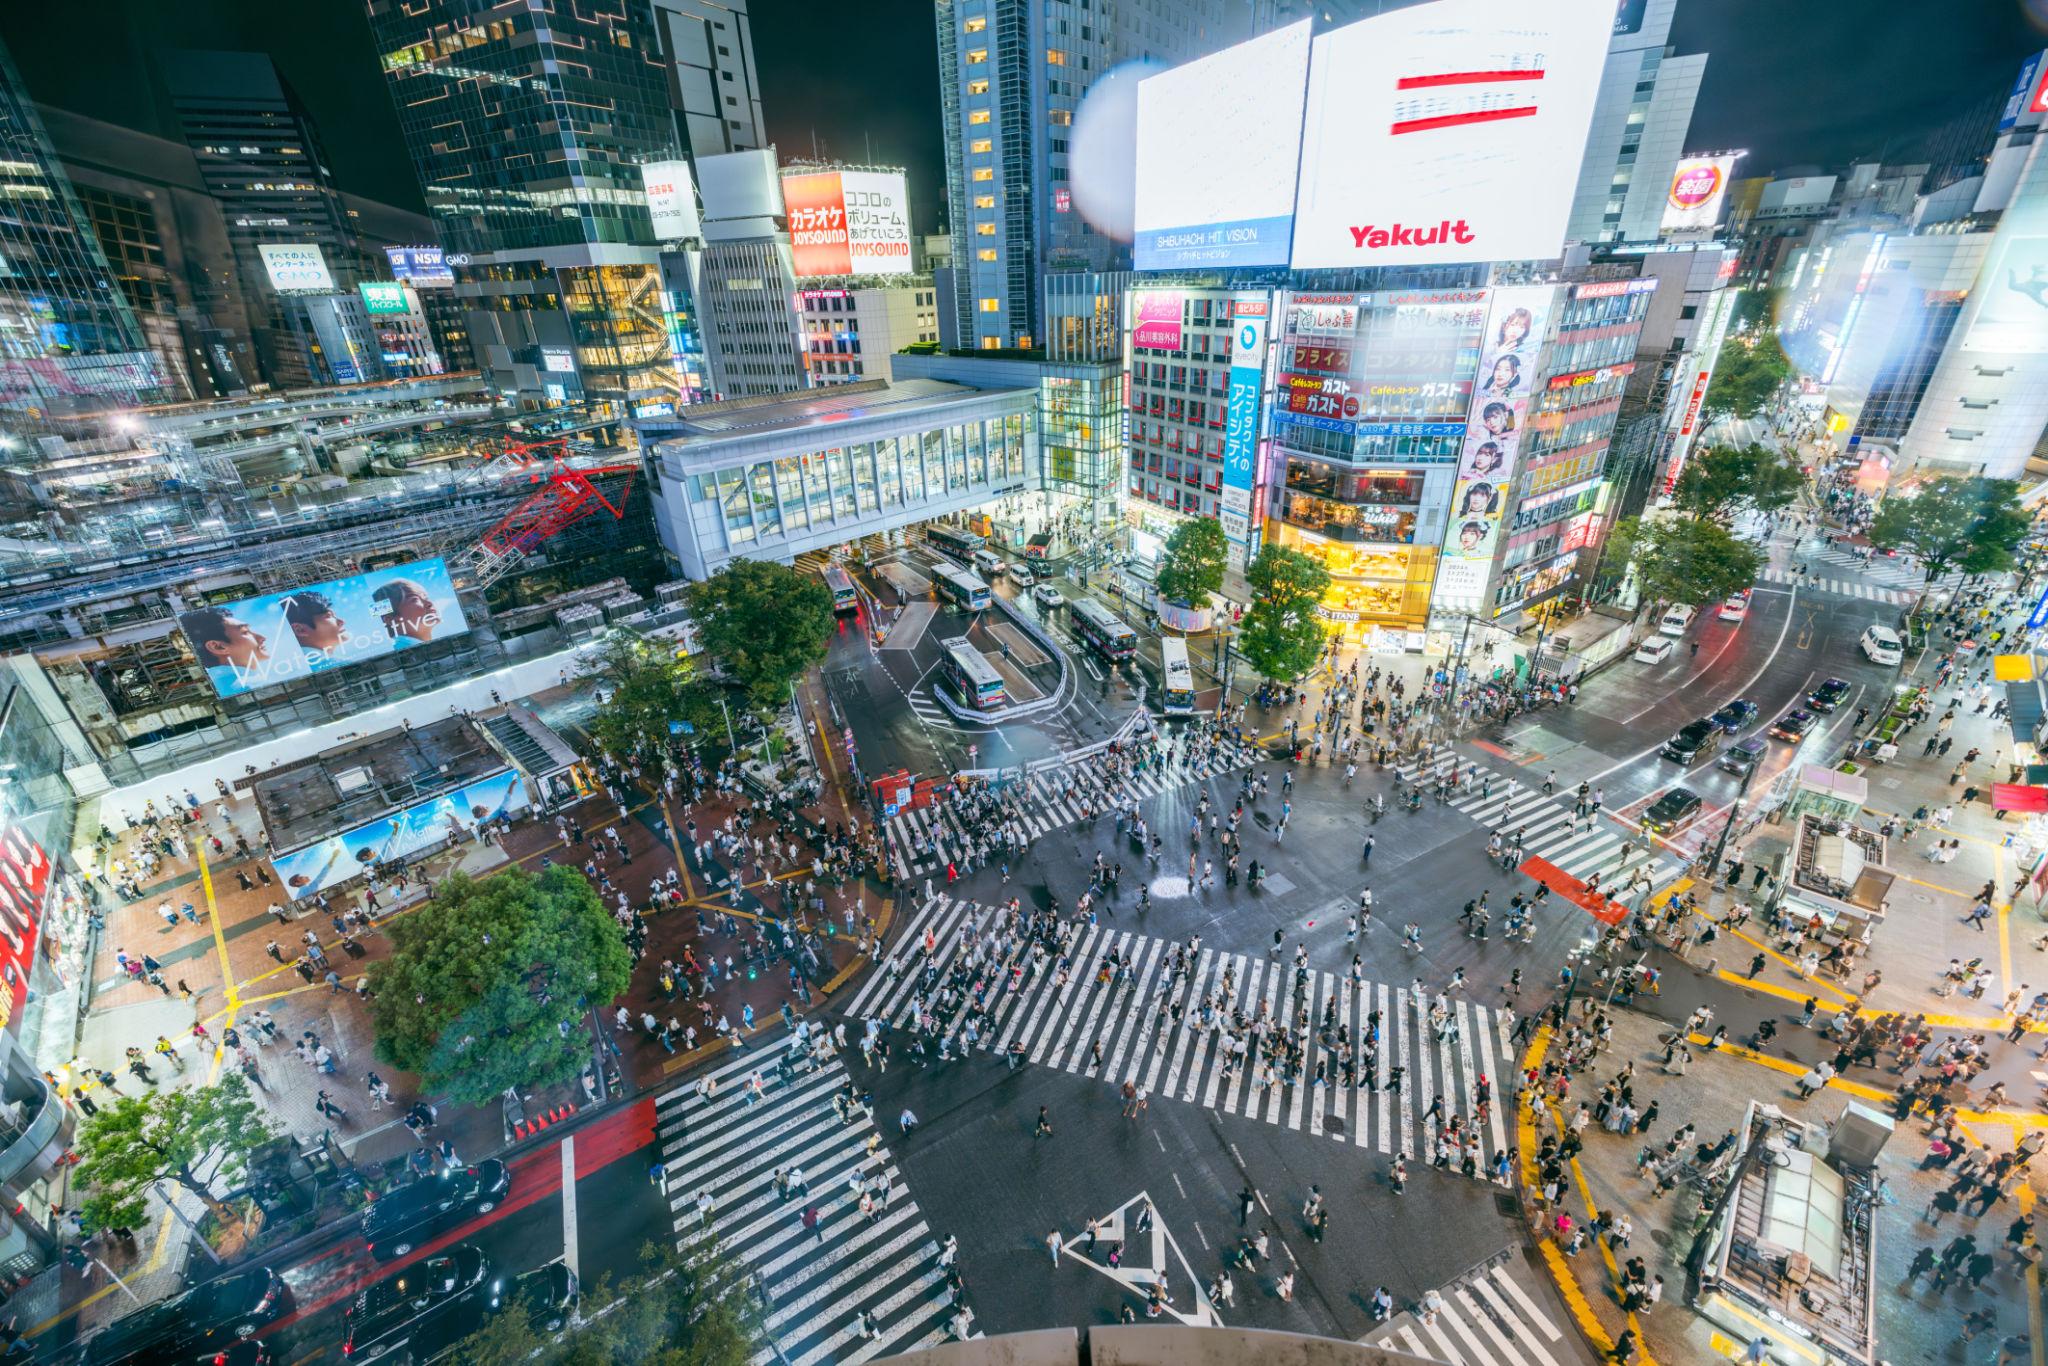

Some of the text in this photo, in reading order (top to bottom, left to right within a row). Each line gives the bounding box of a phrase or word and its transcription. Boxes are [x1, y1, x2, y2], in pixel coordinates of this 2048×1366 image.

[1676, 178, 1715, 195] 楽園
[846, 192, 891, 207] ココロの
[790, 206, 843, 229] カラオケ
[848, 209, 906, 226] ボリューム、
[794, 229, 847, 246] JOYSOUND
[1157, 228, 1258, 248] SHIBUHACHI HIT VISION
[1349, 220, 1476, 248] Yakult
[268, 252, 316, 260] すべての人に
[851, 242, 908, 257] JOYSOUND
[272, 260, 319, 268] インターネット
[391, 254, 406, 265] NSW
[414, 253, 442, 264] NSW
[446, 254, 469, 266] GMO
[276, 271, 322, 280] GMO
[372, 300, 403, 309] ハイスクール
[1317, 310, 1354, 329] しゃぶ葉
[1425, 309, 1483, 328] しゃぶ葉
[1139, 331, 1178, 346] 品川美容外科
[1367, 352, 1452, 369] コンタクト
[1322, 378, 1351, 395] ガスト
[1420, 382, 1462, 398] ガスト
[1307, 393, 1340, 415] ガスト
[1228, 383, 1246, 470] アイシティ
[1239, 385, 1257, 471] コンタクトの
[1391, 423, 1464, 436] 英会話イーオン
[1553, 551, 1578, 570] LUSH
